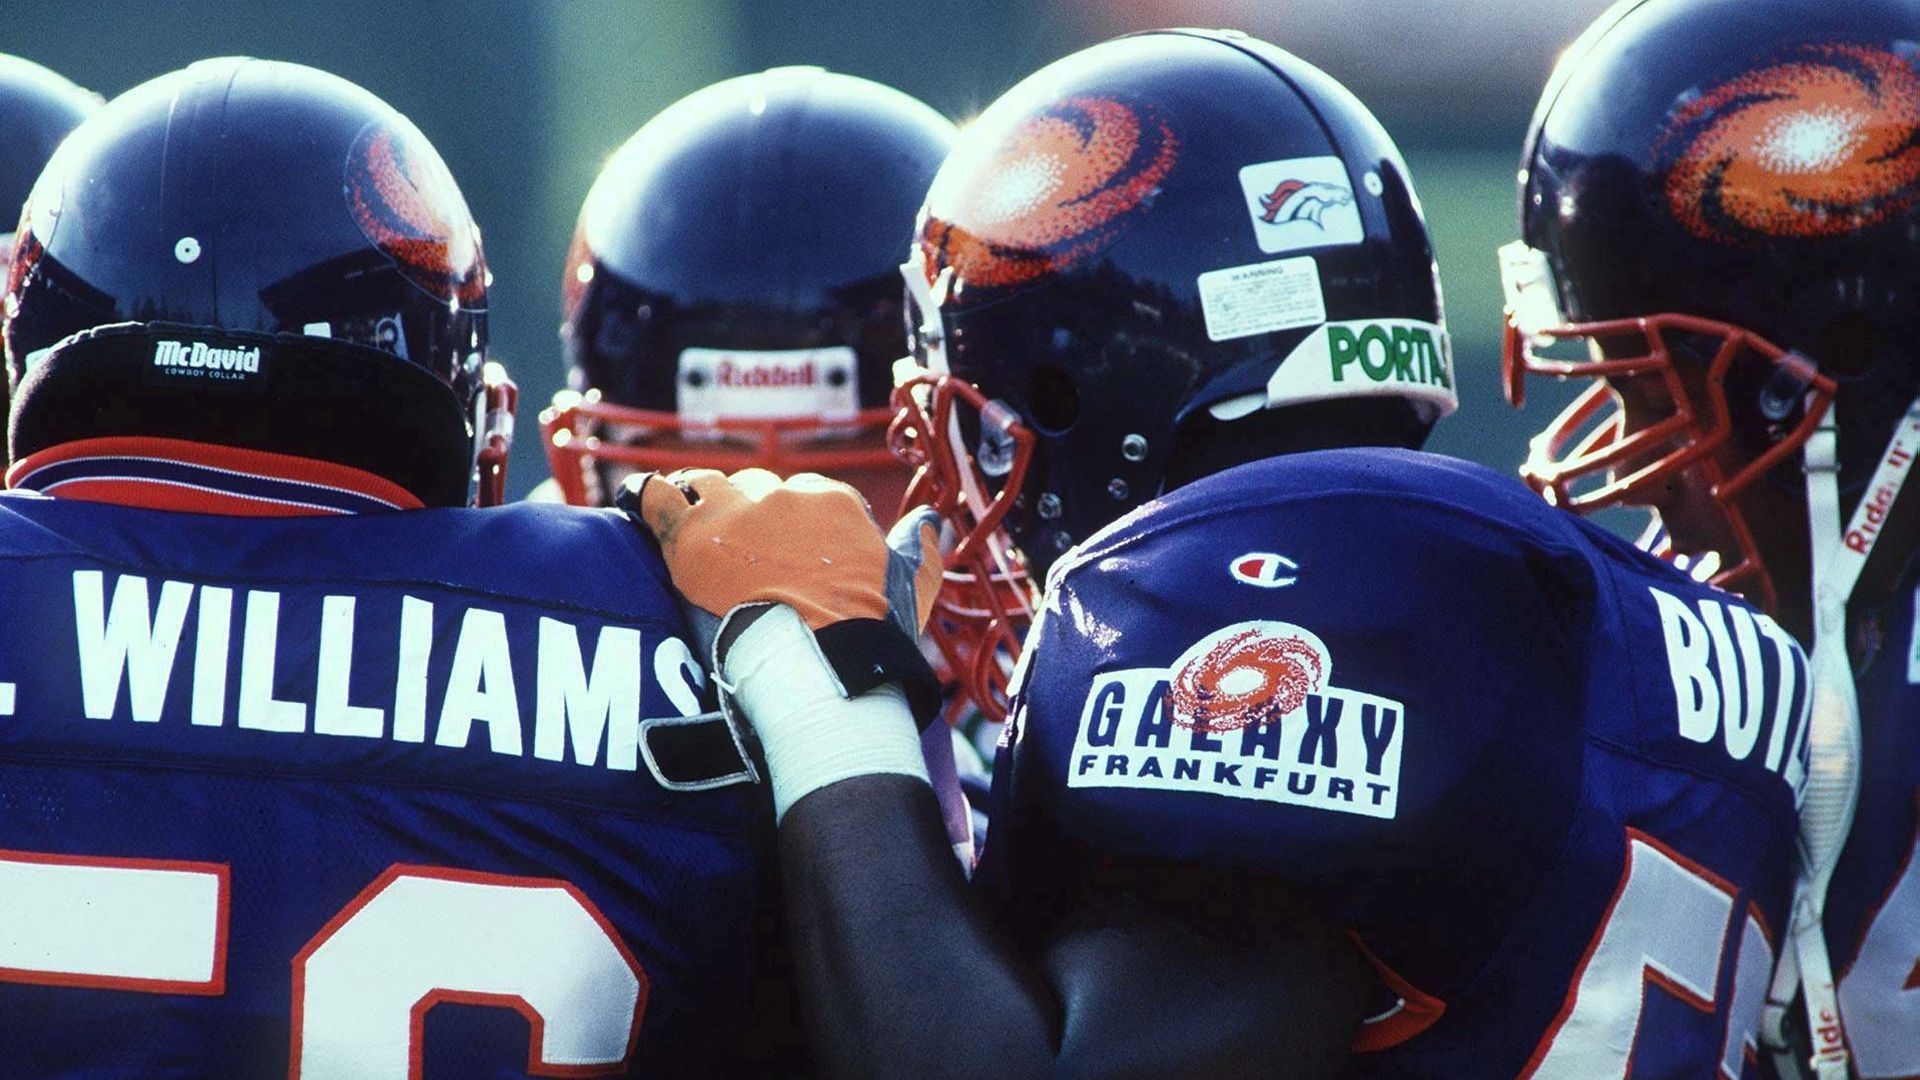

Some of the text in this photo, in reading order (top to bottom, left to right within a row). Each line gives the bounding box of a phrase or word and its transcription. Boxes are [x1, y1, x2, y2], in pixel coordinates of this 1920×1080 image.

[154, 340, 260, 373] McDavid
[165, 367, 245, 380] COWBOY COLLAR
[1327, 324, 1451, 390] PORTA
[1078, 754, 1391, 806] FRANKFURT
